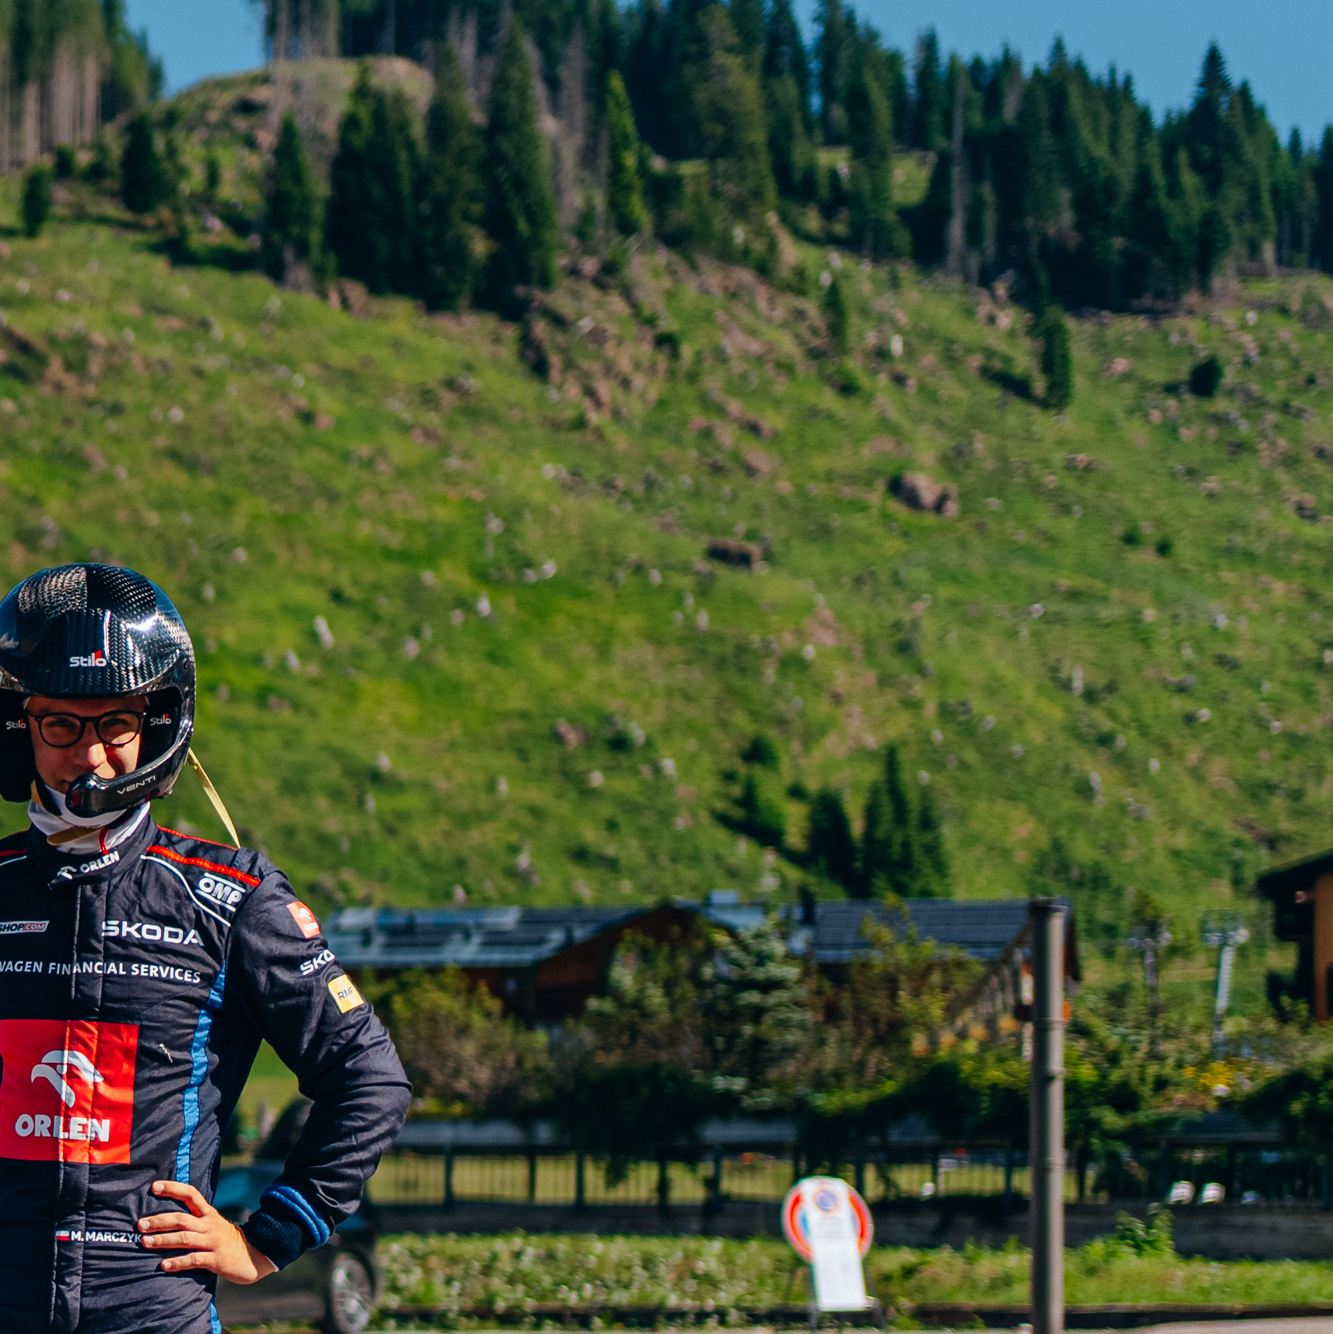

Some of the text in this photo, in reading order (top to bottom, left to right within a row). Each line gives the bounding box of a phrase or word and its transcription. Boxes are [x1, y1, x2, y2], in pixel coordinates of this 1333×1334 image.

[69, 651, 107, 667] Stilo
[6, 719, 26, 730] Stilo
[117, 775, 156, 795] VENTI
[80, 851, 120, 873] ORLEN
[198, 877, 243, 904] OMP
[101, 920, 205, 947] SKODA
[48, 962, 126, 976] FINANCIAL
[131, 963, 201, 983] SERVICES
[300, 949, 336, 976] SKO
[15, 1113, 110, 1142] ORLEN
